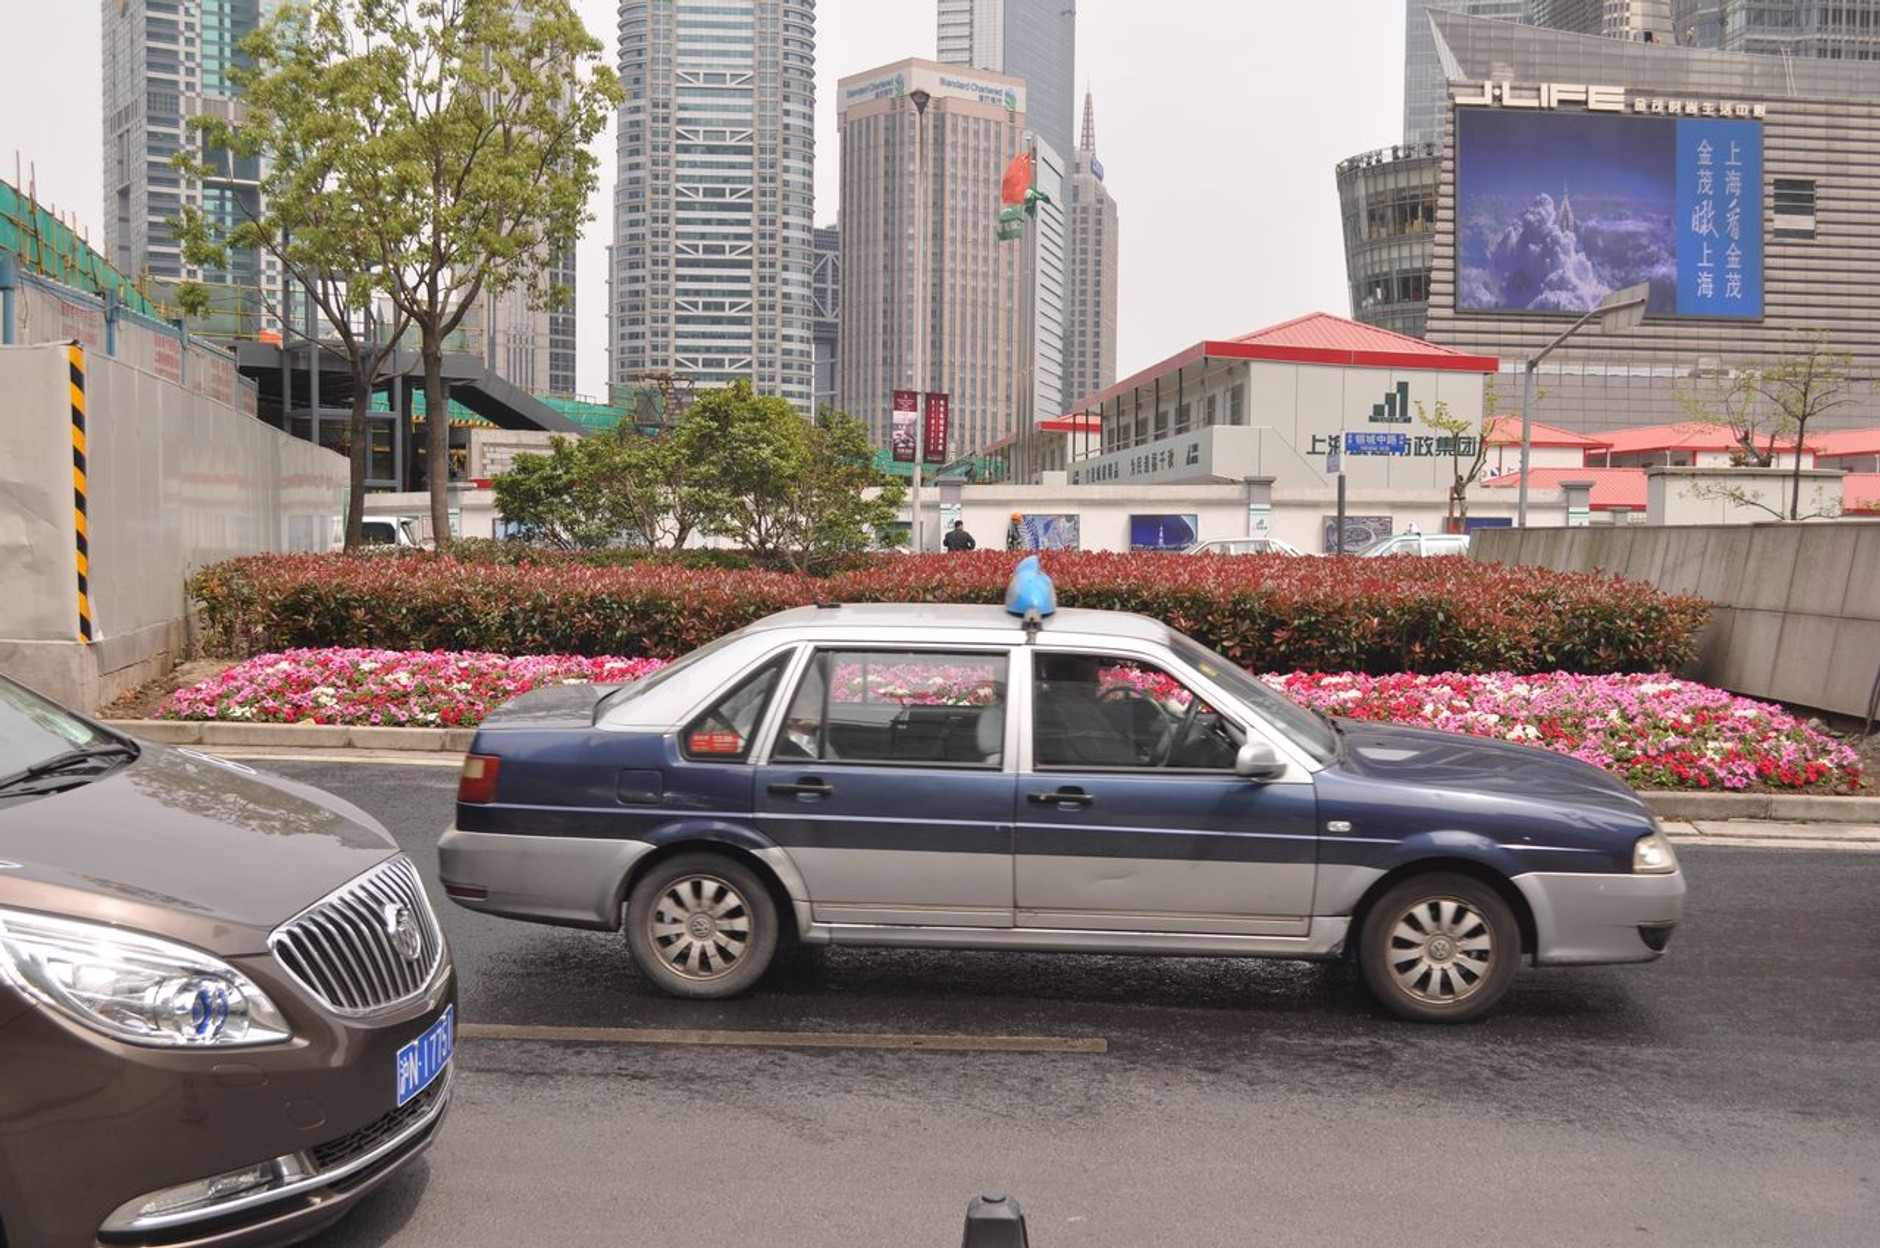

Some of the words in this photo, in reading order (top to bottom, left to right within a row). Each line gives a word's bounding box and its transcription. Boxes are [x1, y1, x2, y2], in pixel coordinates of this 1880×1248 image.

[1634, 98, 1766, 117] 金茂时尚生活中心
[1691, 138, 1719, 299] 金茂瞰上海
[1725, 141, 1742, 299] 上海看金茂
